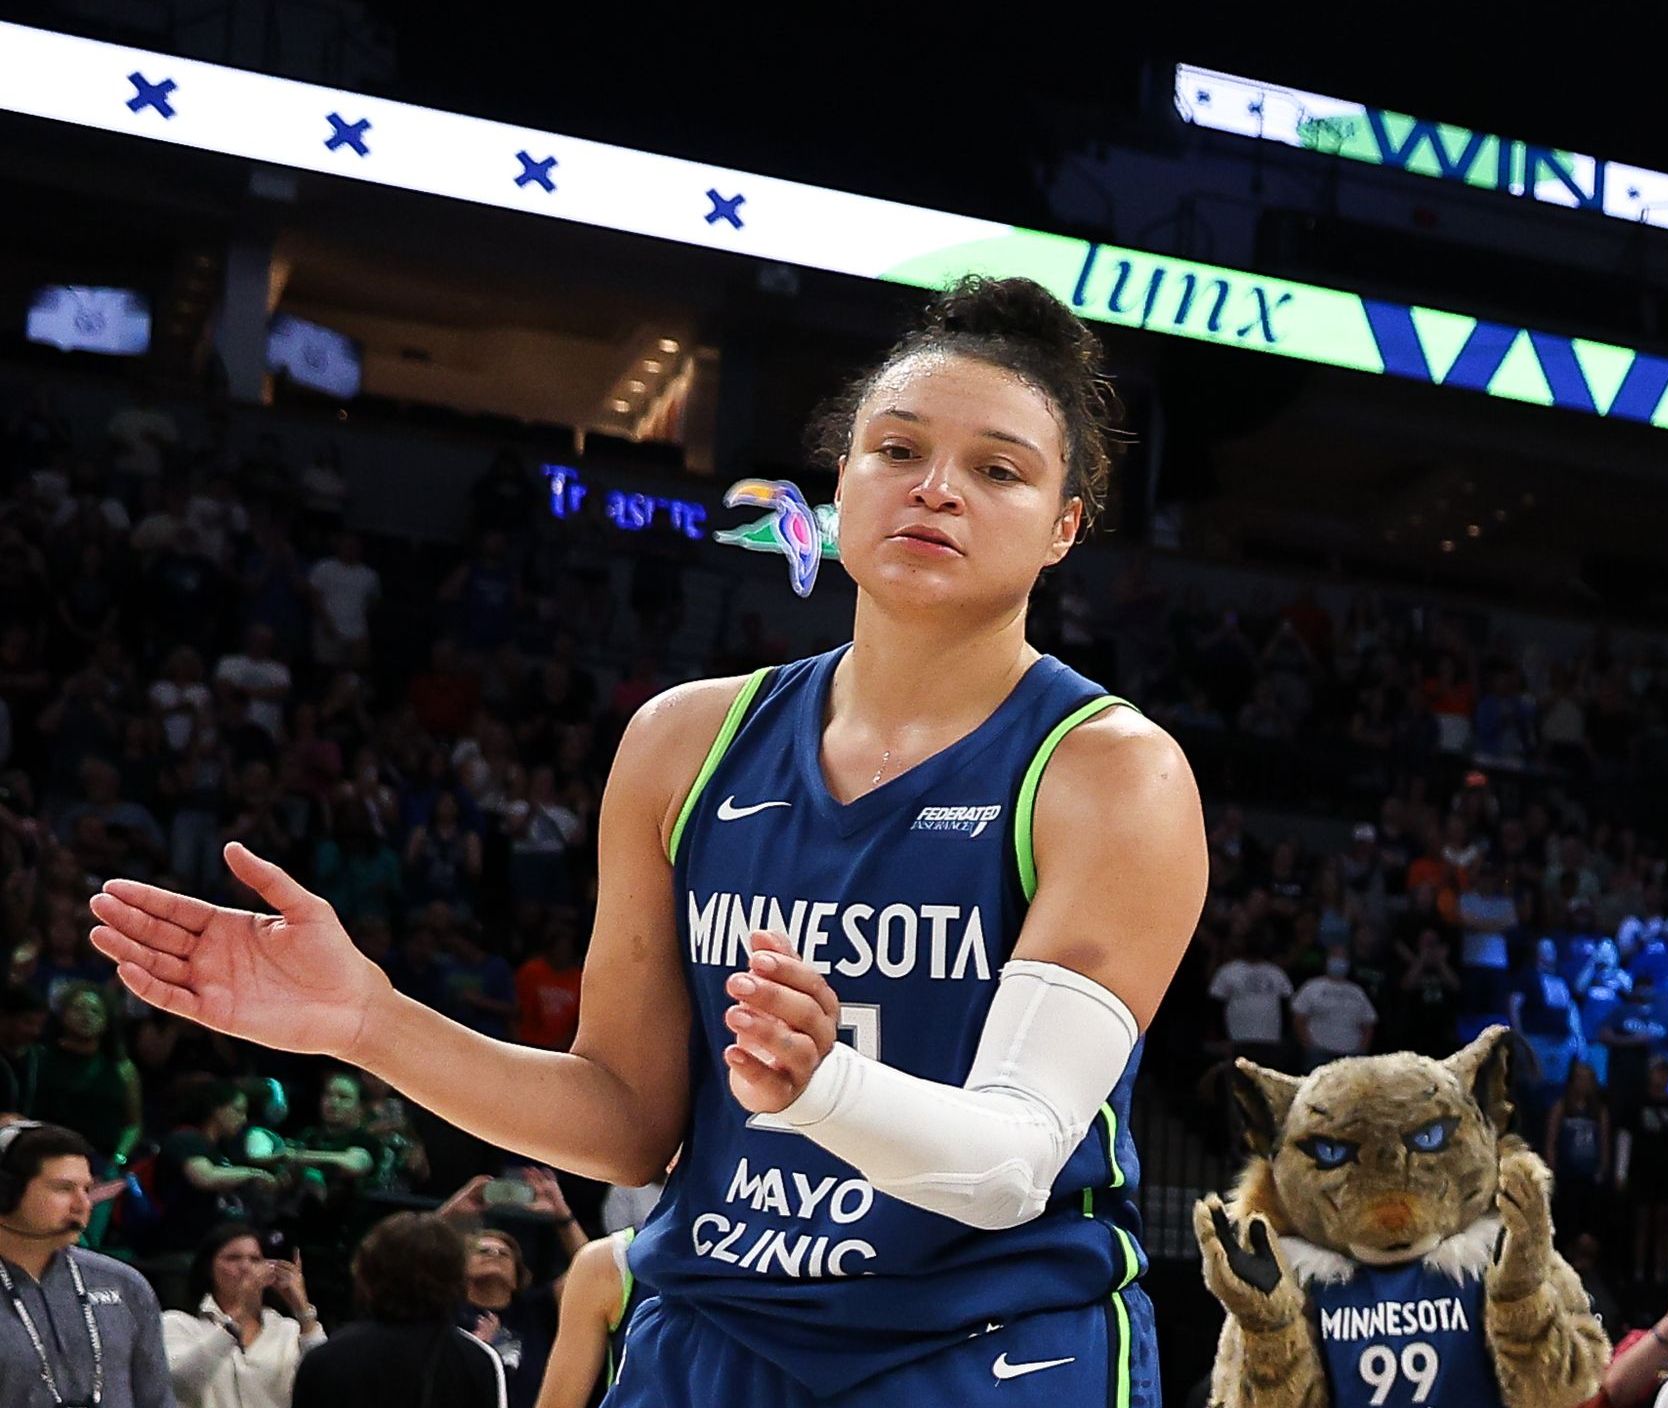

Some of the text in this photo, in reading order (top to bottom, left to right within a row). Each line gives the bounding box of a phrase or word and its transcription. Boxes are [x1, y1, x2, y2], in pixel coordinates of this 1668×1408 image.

[1072, 241, 1293, 345] lynx
[916, 804, 1002, 821] FEDERATED
[688, 890, 991, 981] MINNESOTA
[726, 1157, 874, 1225] MAYO
[692, 1212, 877, 1278] CLINIC
[1321, 1297, 1469, 1342] MINNESOTA
[1359, 1342, 1440, 1407] 99
